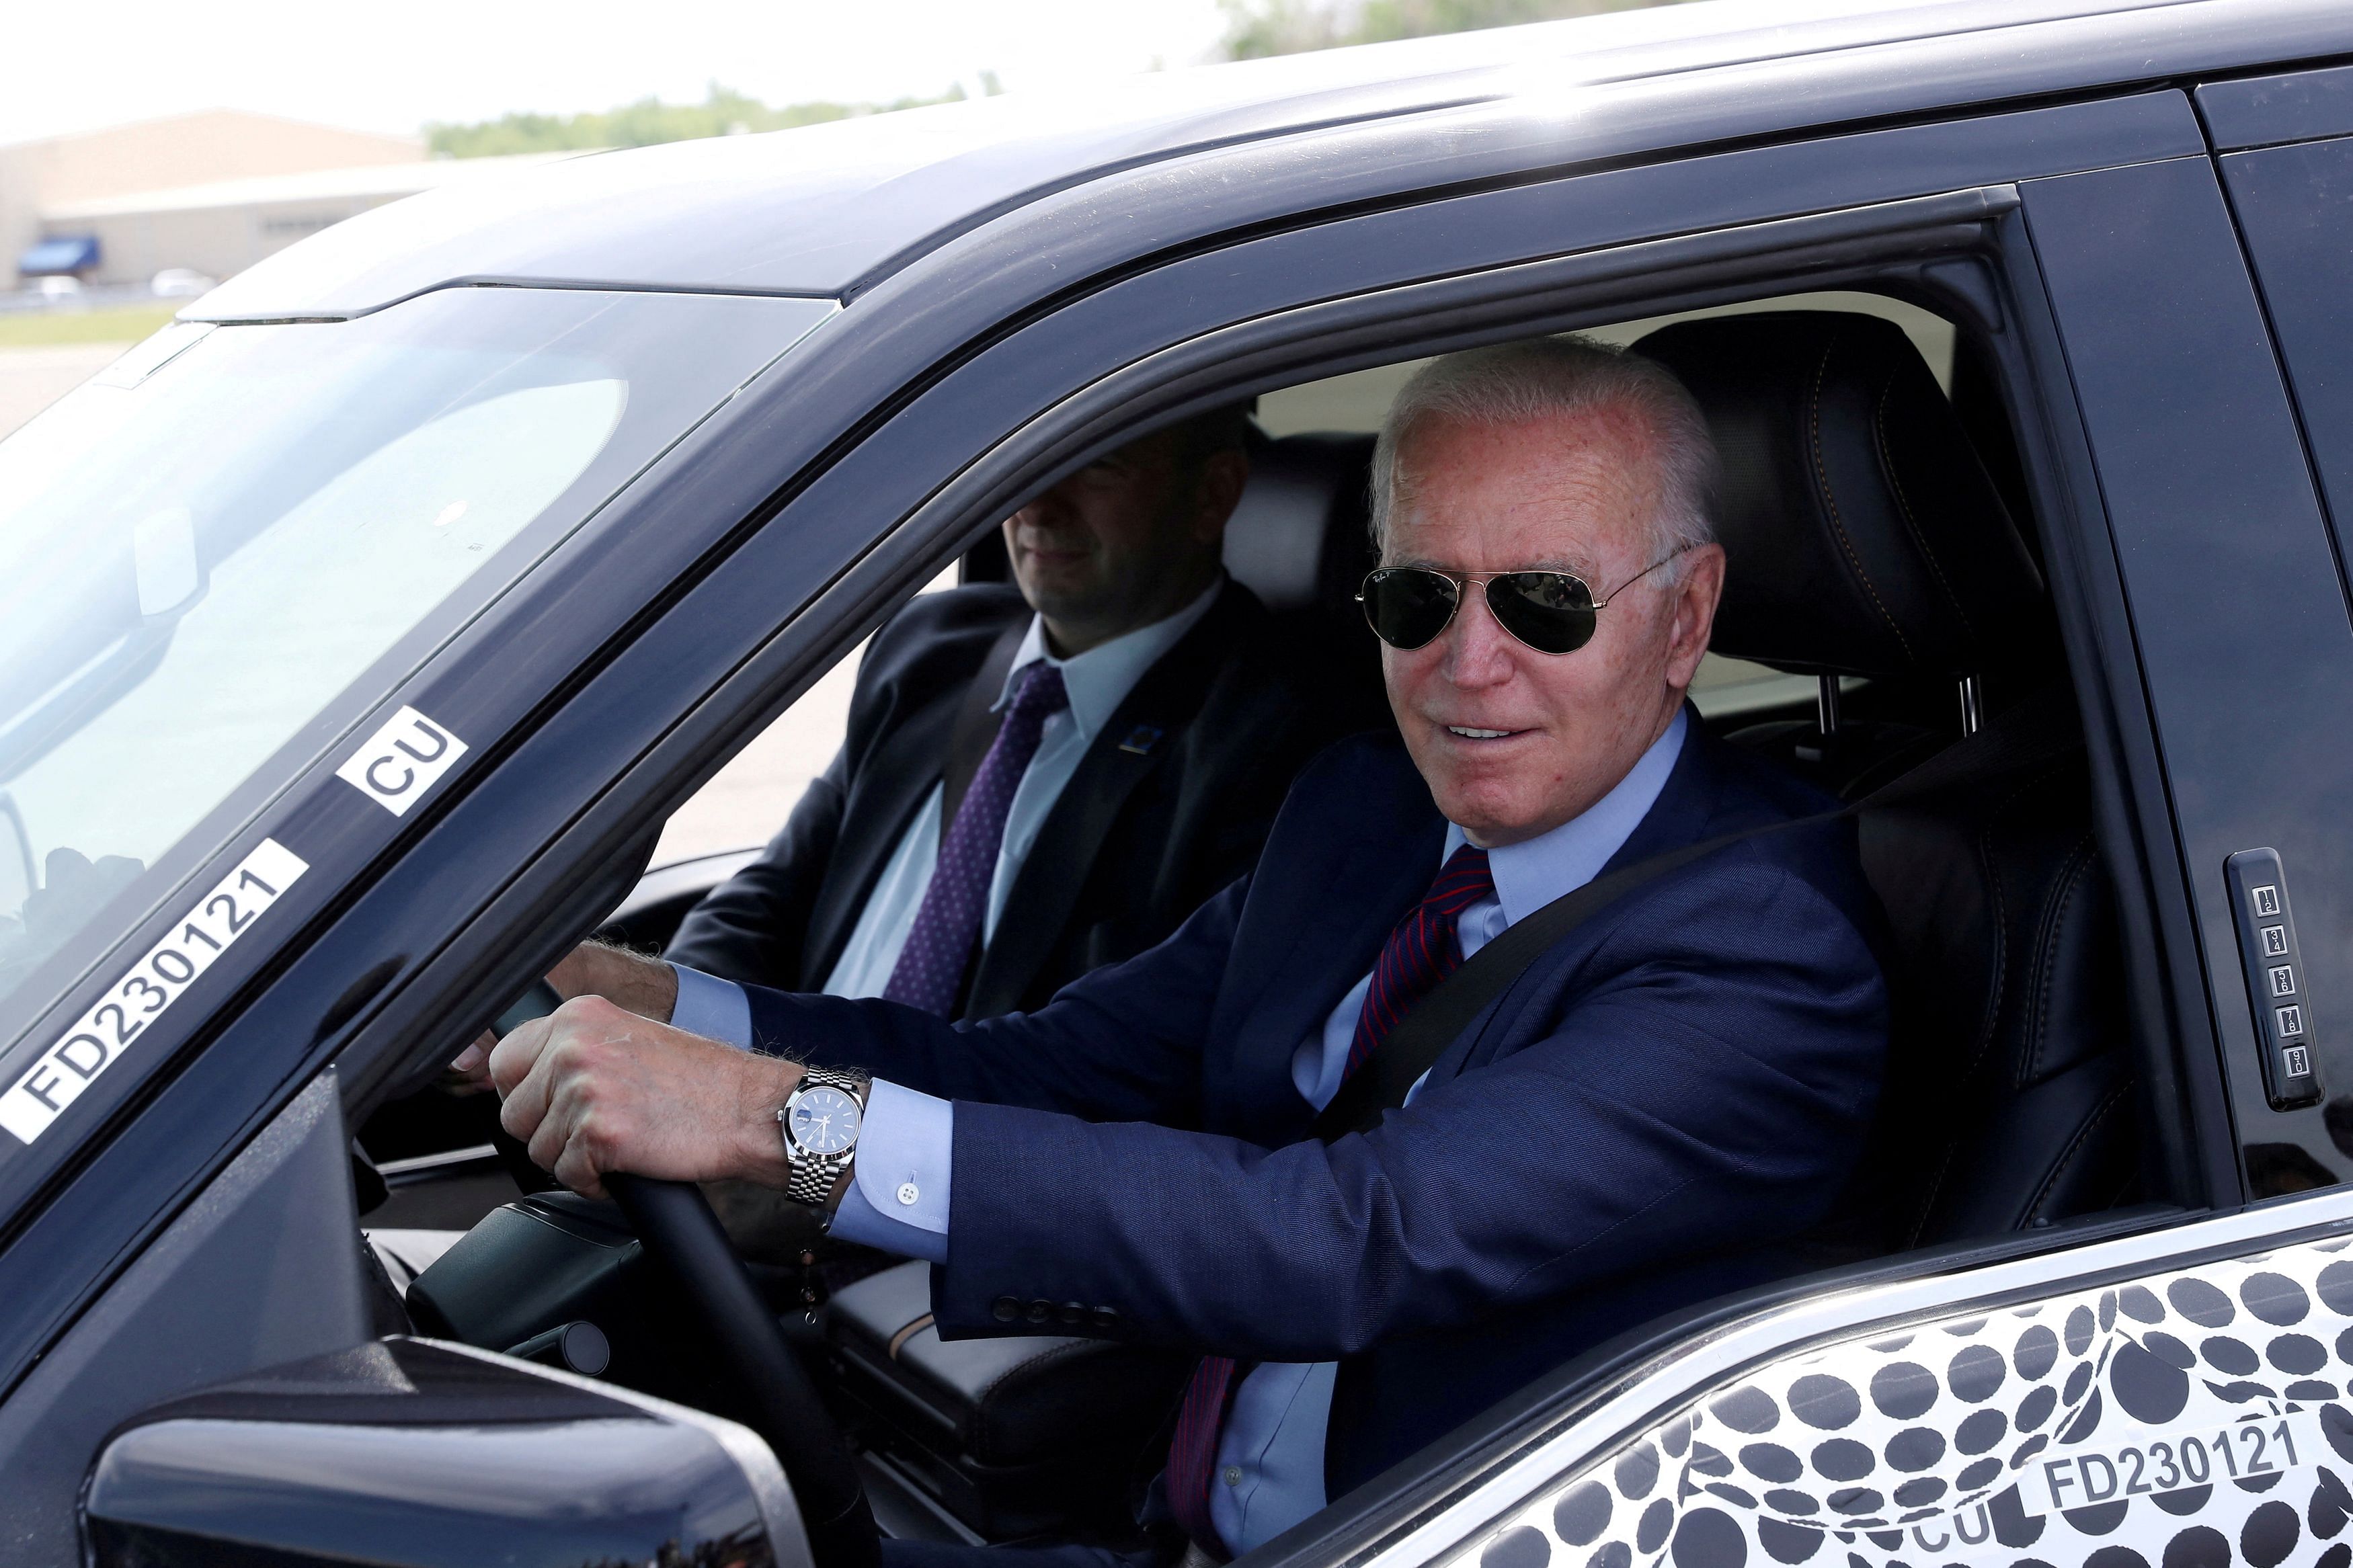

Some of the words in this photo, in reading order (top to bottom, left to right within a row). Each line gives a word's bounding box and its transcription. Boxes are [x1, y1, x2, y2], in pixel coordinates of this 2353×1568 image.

[366, 720, 447, 795] CU
[23, 870, 277, 1111] FD230121
[2044, 1419, 2298, 1508] FD230121
